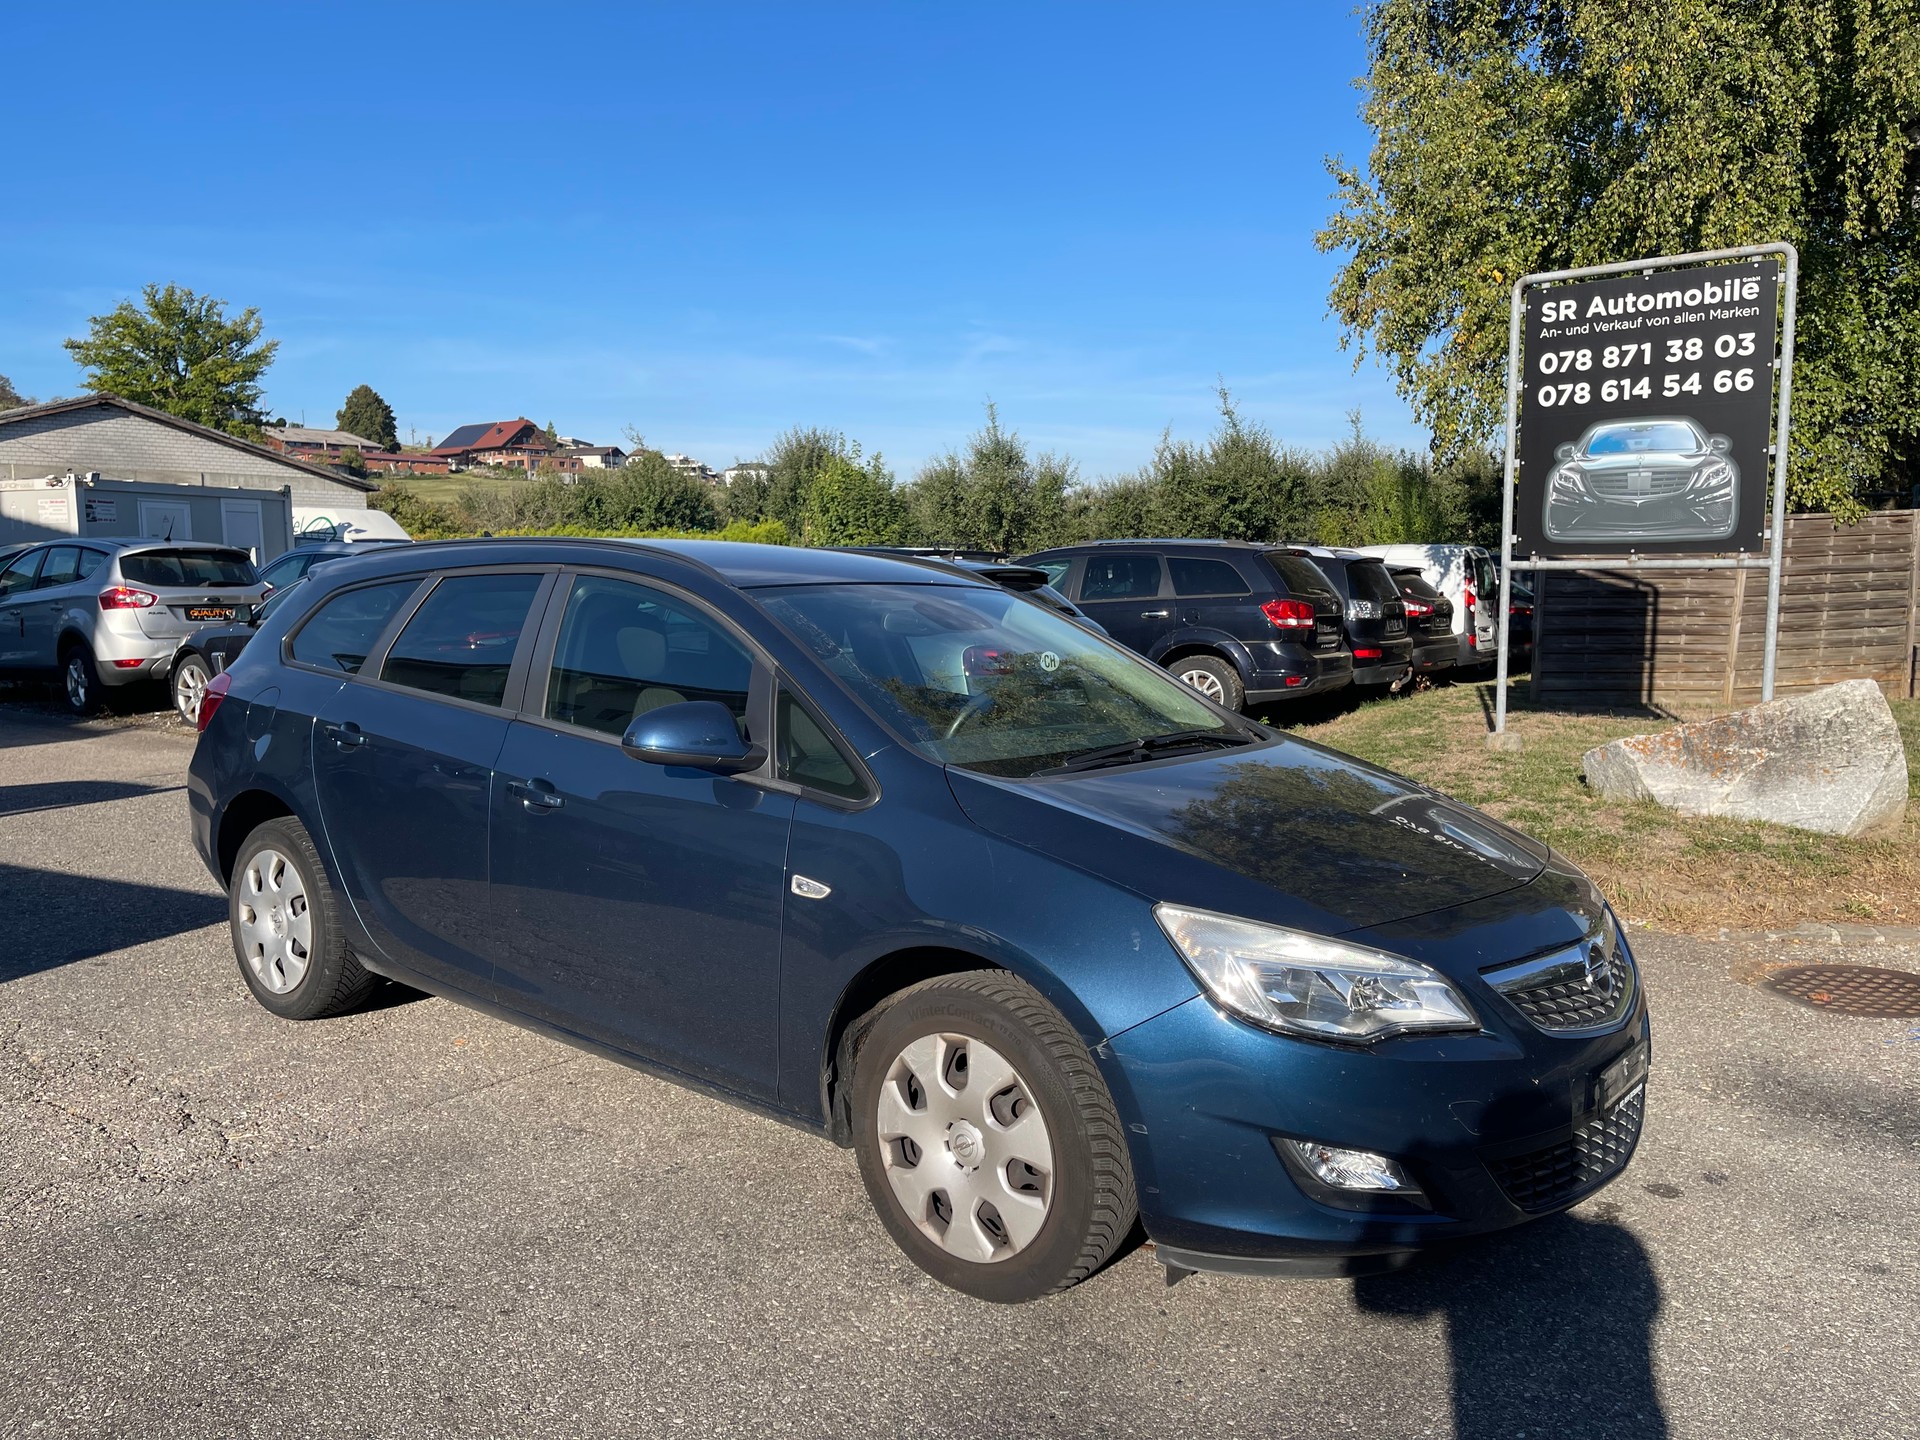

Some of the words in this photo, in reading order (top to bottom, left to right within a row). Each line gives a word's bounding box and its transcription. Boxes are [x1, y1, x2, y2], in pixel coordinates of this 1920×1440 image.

[1540, 299, 1578, 323] SR
[1585, 277, 1760, 319] Automobile
[1539, 327, 1563, 339] An-
[1565, 322, 1590, 336] und
[1592, 319, 1643, 333] Verkauf
[1645, 316, 1670, 327] von
[1673, 311, 1706, 325] allen
[1709, 305, 1760, 321] Marken
[1539, 348, 1593, 375] 078
[1601, 342, 1652, 369] 871
[1664, 337, 1704, 363] 38
[1714, 331, 1756, 359] 03
[1537, 381, 1591, 408] 078
[1600, 376, 1652, 403] 614
[1661, 371, 1703, 398] 54
[1713, 367, 1755, 394] 66
[189, 609, 225, 617] QUALITY
[1044, 654, 1057, 668] CH
[907, 1003, 996, 1031] WinterContact
